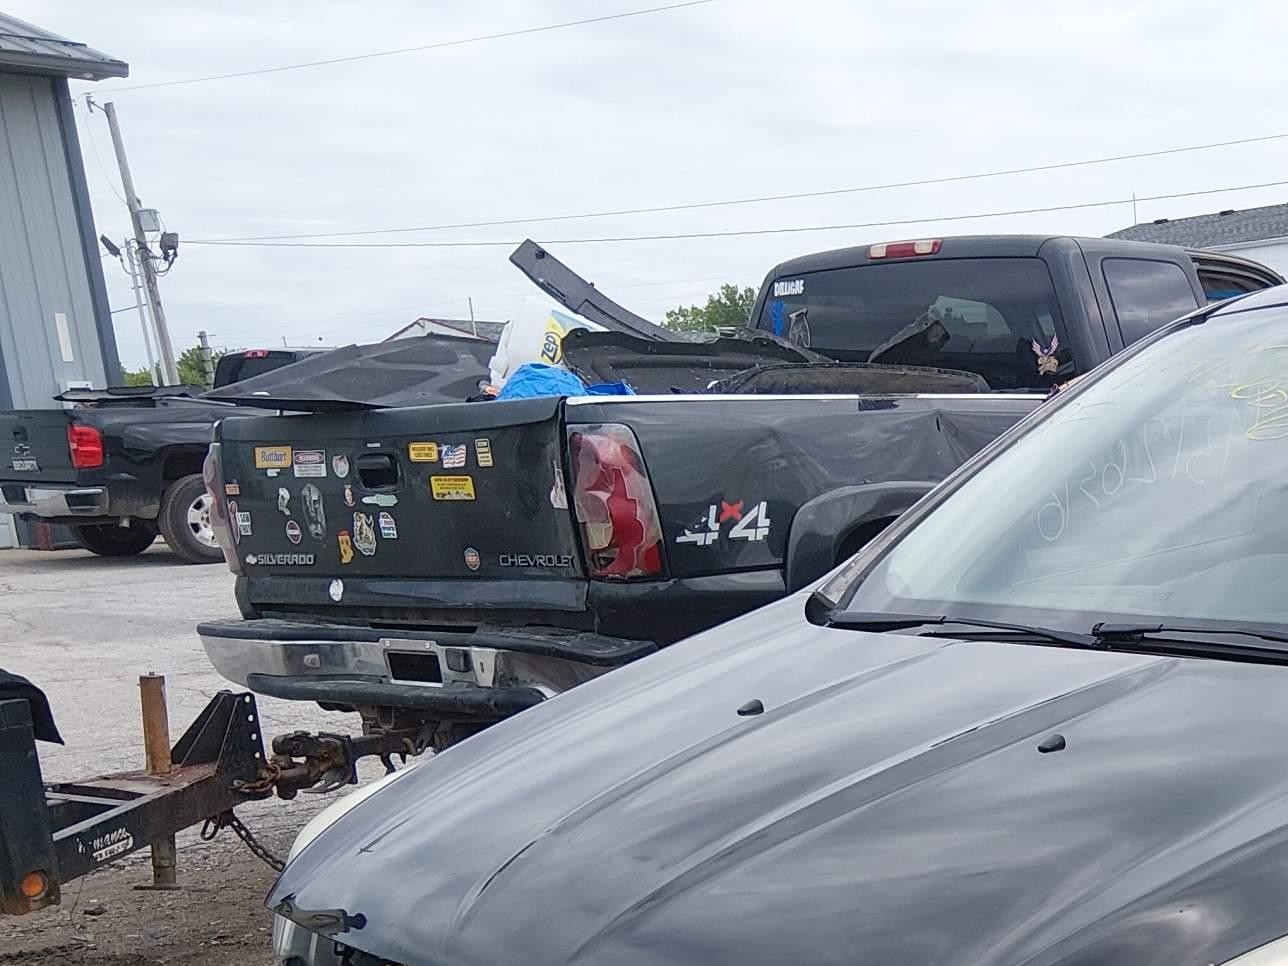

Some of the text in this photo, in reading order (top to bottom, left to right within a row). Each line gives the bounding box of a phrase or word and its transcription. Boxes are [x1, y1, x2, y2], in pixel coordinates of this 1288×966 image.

[774, 280, 804, 297] DILLIGAF
[261, 450, 287, 463] Butthurt
[258, 553, 315, 565] SILVERADO
[499, 554, 573, 567] CHEVROLET
